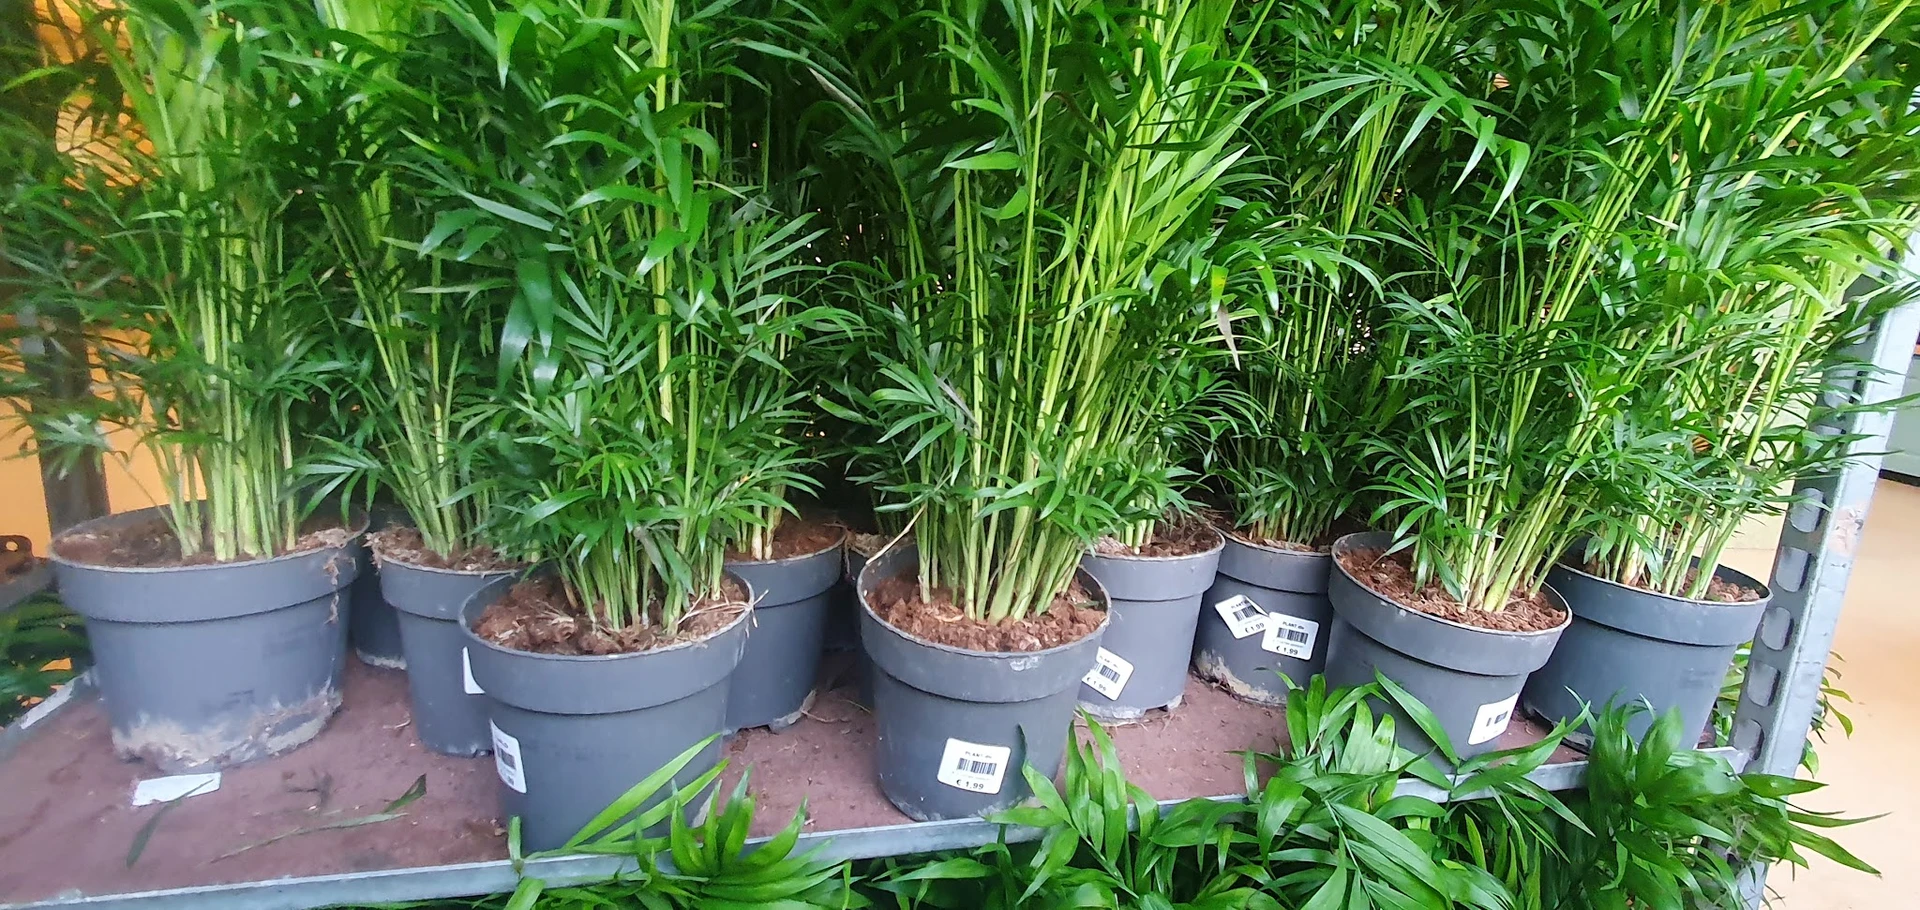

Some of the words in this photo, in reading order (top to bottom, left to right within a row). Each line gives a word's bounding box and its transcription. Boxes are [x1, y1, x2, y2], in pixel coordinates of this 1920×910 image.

[1250, 622, 1265, 632] 1.99
[1283, 647, 1299, 656] 1.99
[966, 781, 984, 790] 1.99
